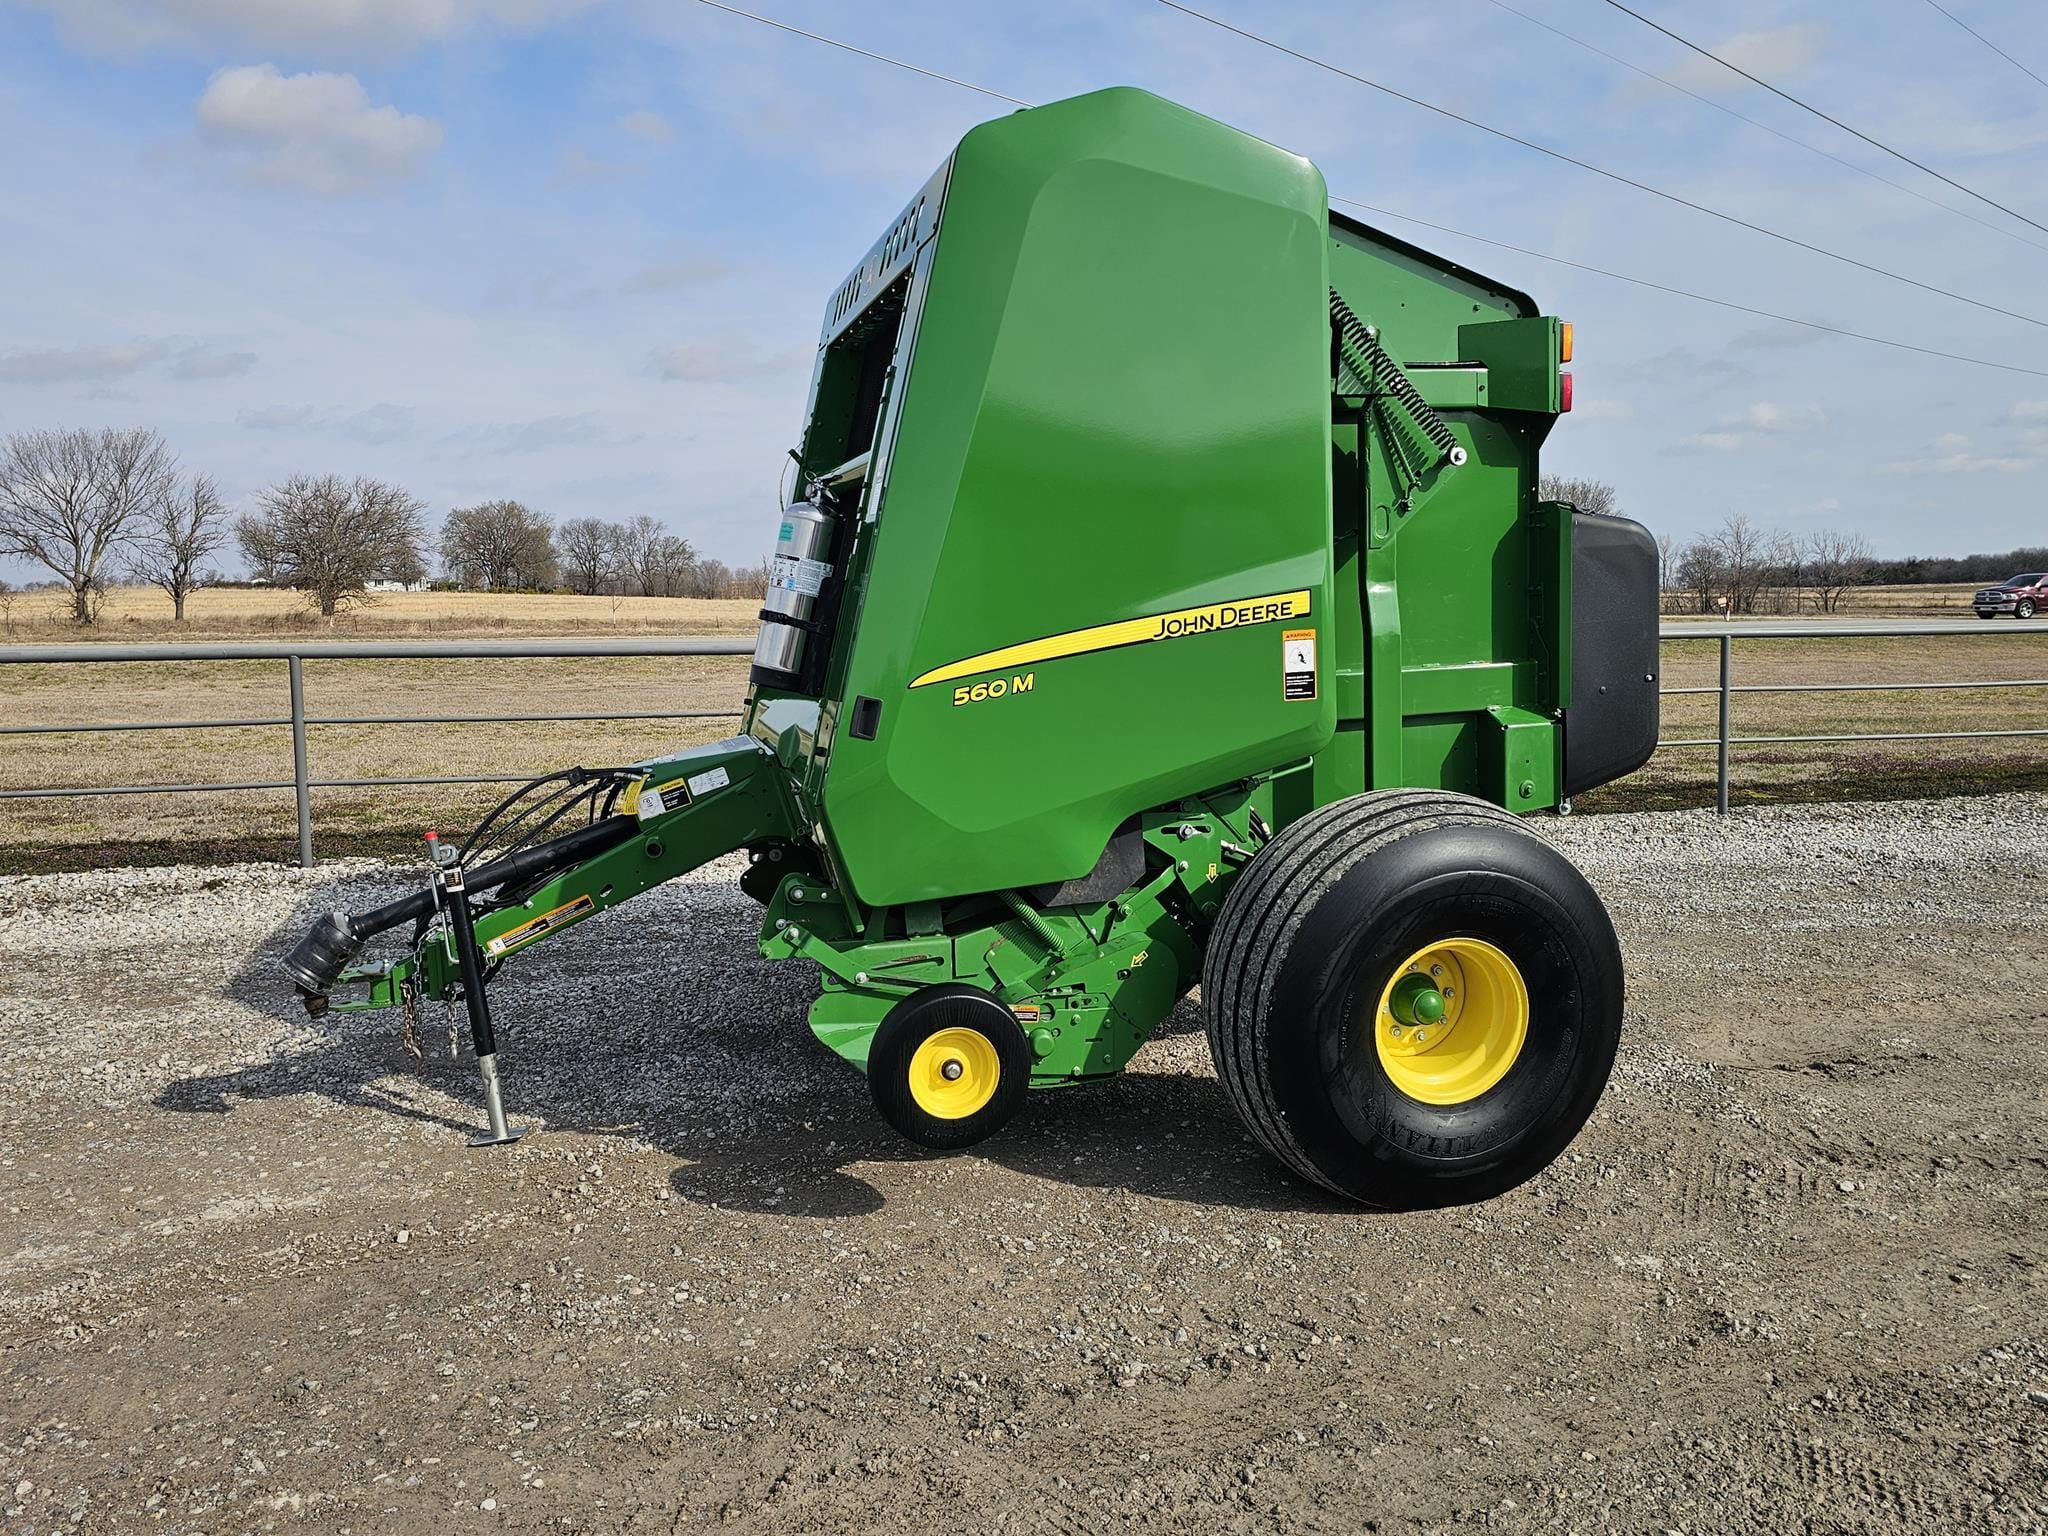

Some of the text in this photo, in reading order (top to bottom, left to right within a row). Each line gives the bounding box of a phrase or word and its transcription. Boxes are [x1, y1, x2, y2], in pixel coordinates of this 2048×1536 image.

[1153, 601, 1293, 638] JOHN DEERE
[953, 672, 1034, 706] 560 M
